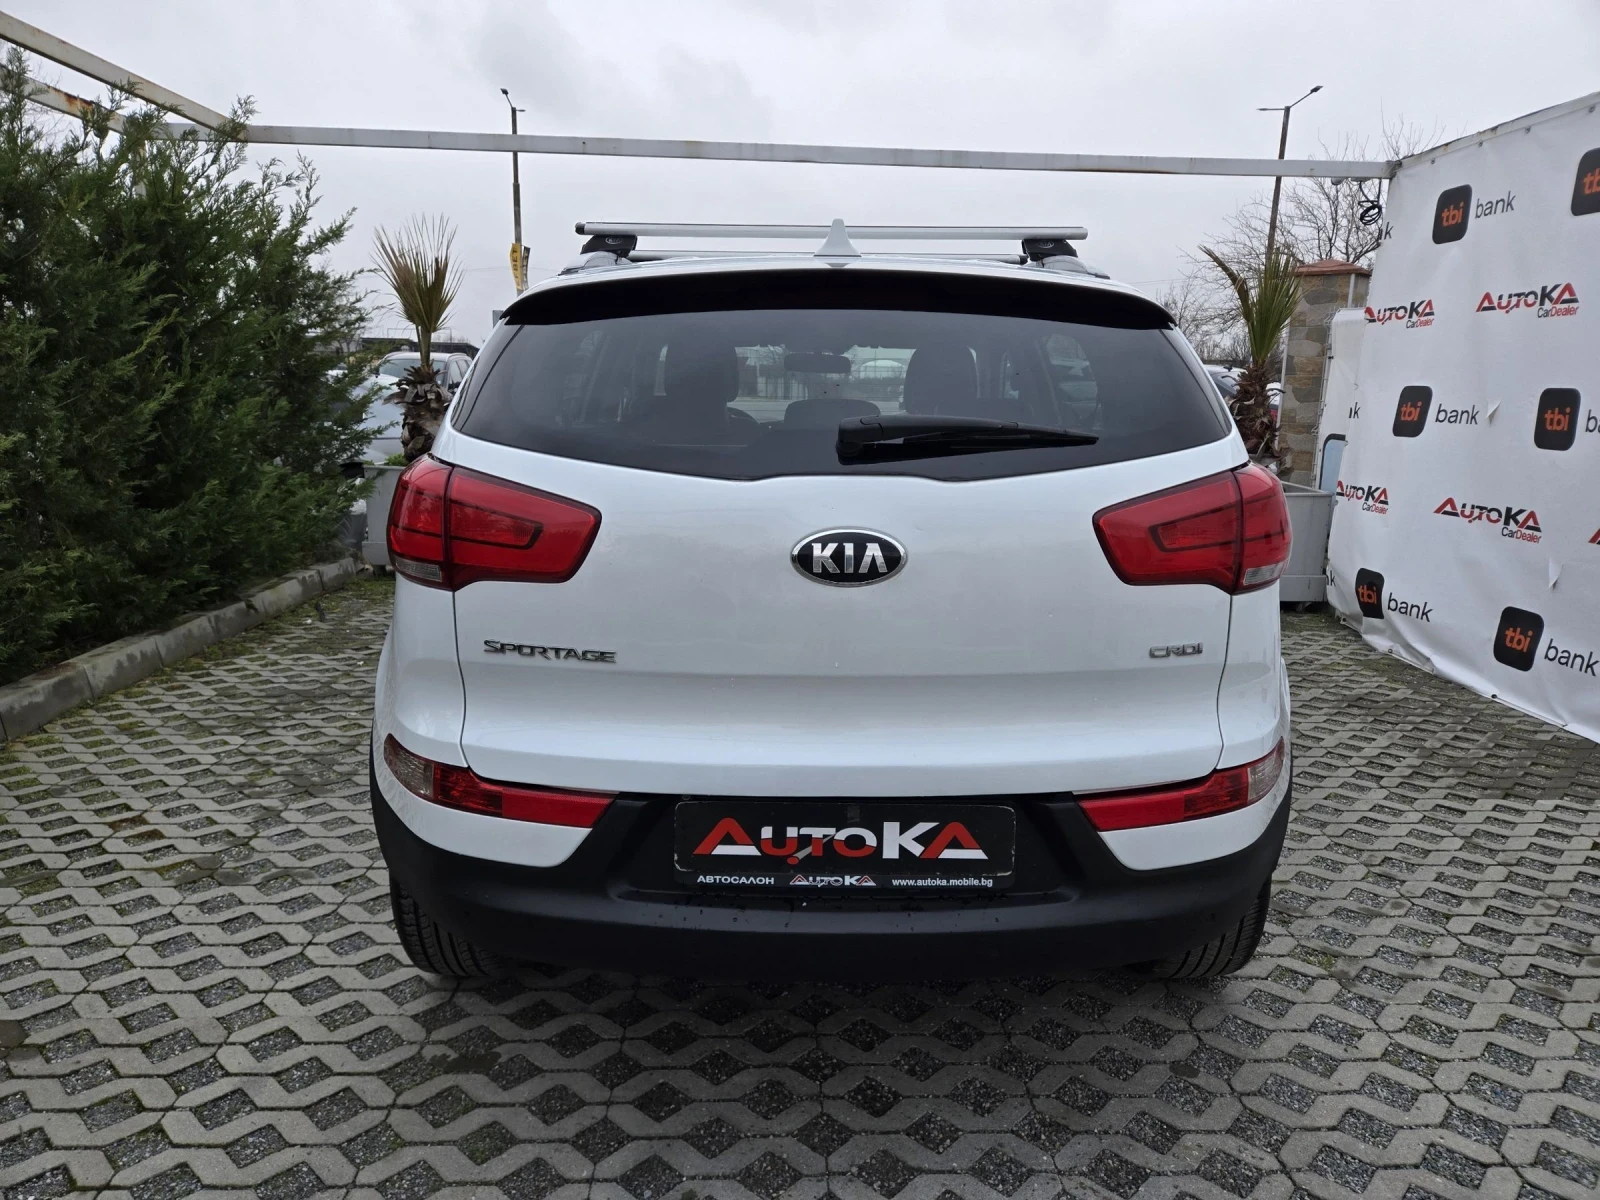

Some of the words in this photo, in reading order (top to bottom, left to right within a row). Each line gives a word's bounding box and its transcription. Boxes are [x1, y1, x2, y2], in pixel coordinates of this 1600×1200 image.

[1441, 202, 1465, 227] tbi
[1475, 191, 1517, 219] bank
[1476, 282, 1579, 314] AUTOKA
[1406, 317, 1435, 328] CarDealer
[1537, 306, 1579, 318] CarDealer
[1400, 401, 1422, 421] tbi
[1435, 403, 1480, 425] bank
[1544, 407, 1571, 431] tbi
[1433, 497, 1542, 532] AUTOKA
[1501, 526, 1542, 544] CarDealer
[811, 542, 889, 573] KIA
[1358, 584, 1377, 605] tbi
[1387, 592, 1433, 622] bank
[484, 639, 616, 663] SPORTAGE
[1505, 627, 1533, 653] tbi
[1544, 638, 1600, 677] bank
[692, 817, 989, 865] AUTOKA
[697, 875, 774, 885] АВТОСАЛОН
[892, 877, 993, 887] www.autoka.mobile.bg
